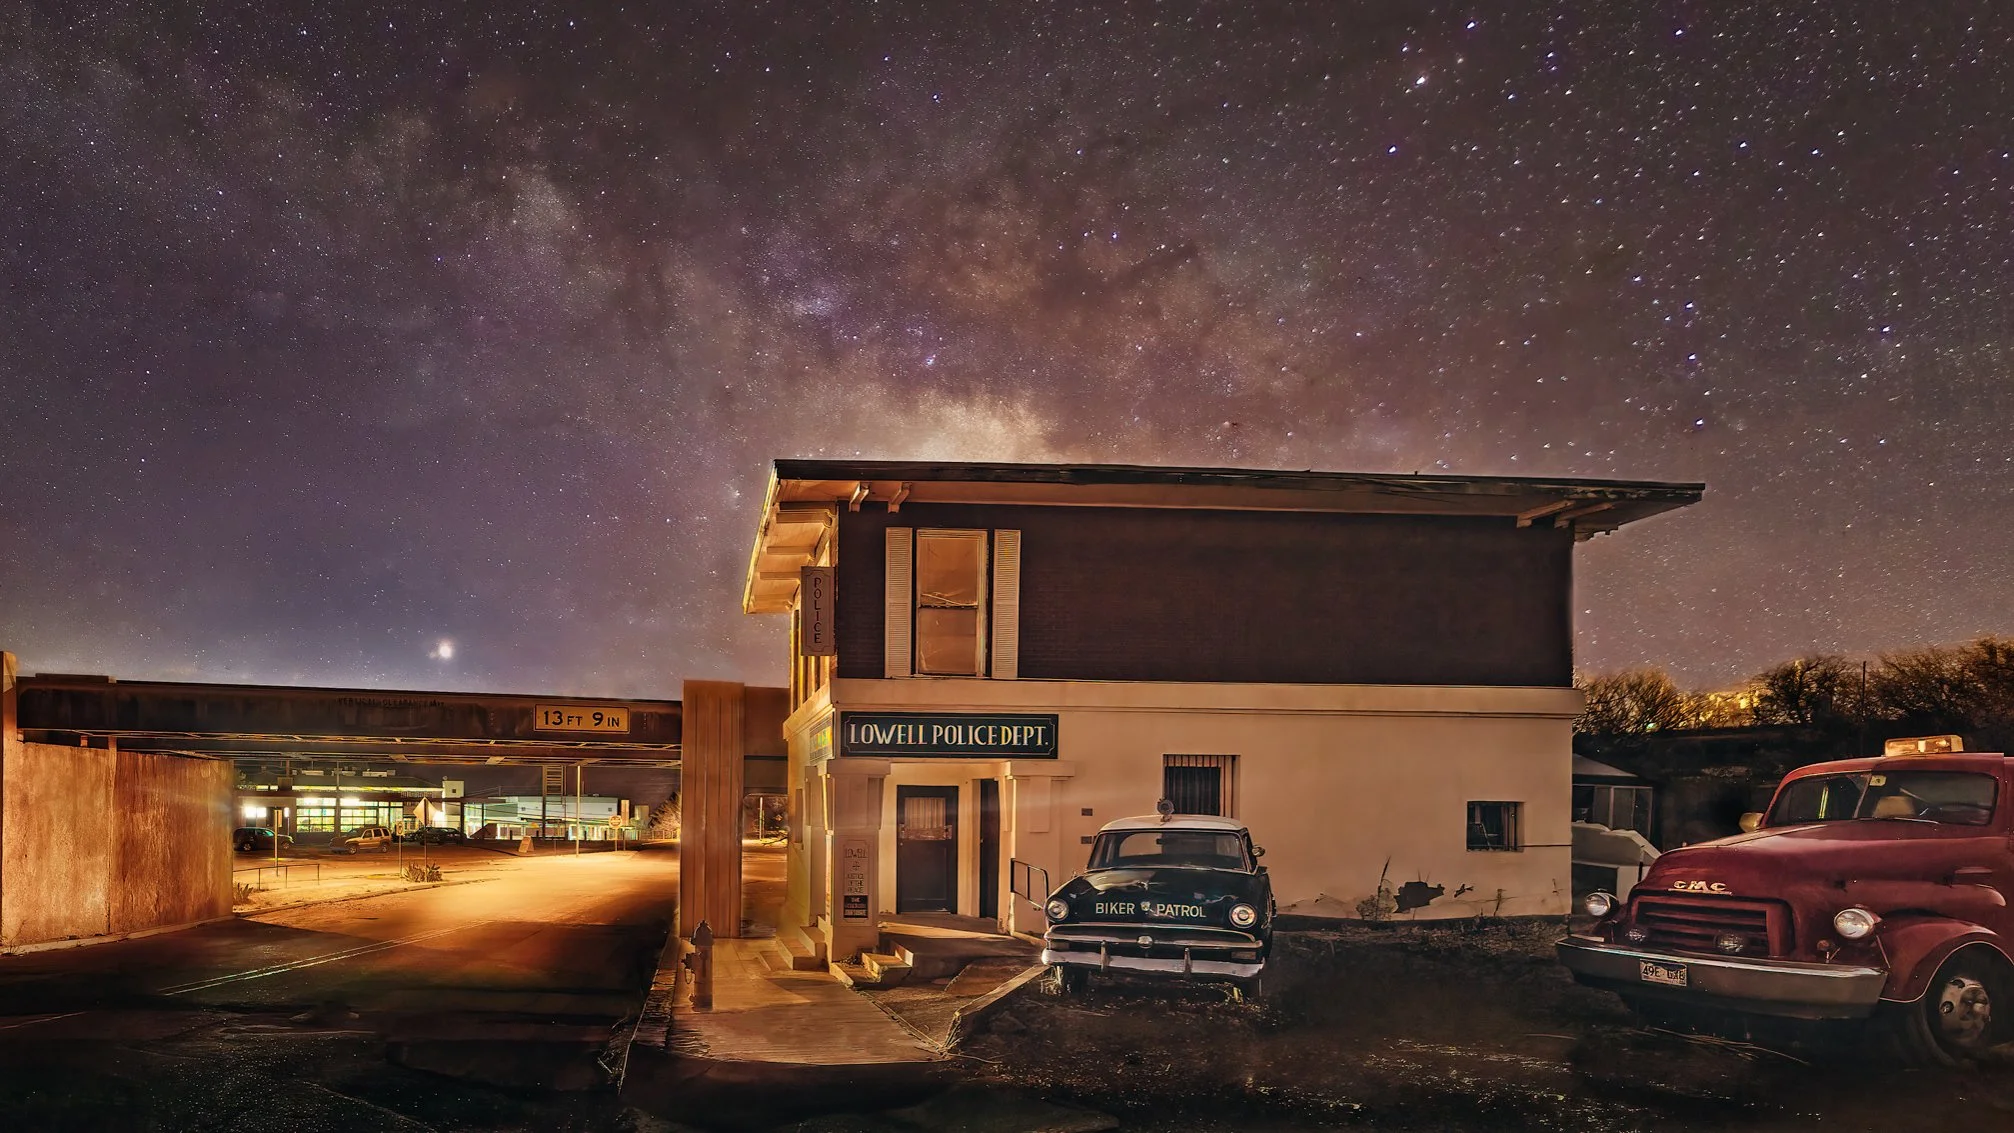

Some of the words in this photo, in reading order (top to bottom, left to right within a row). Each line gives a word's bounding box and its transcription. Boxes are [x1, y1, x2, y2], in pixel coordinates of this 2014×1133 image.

[813, 577, 822, 644] POLICE
[544, 710, 563, 725] 13
[567, 715, 583, 726] FT
[592, 711, 604, 727] 9
[607, 716, 620, 728] IN
[850, 723, 928, 745] LOWELL
[931, 724, 998, 746] POLICE
[999, 725, 1049, 747] DEPT.
[1095, 902, 1135, 915] BIKER
[1156, 903, 1207, 918] PATROL
